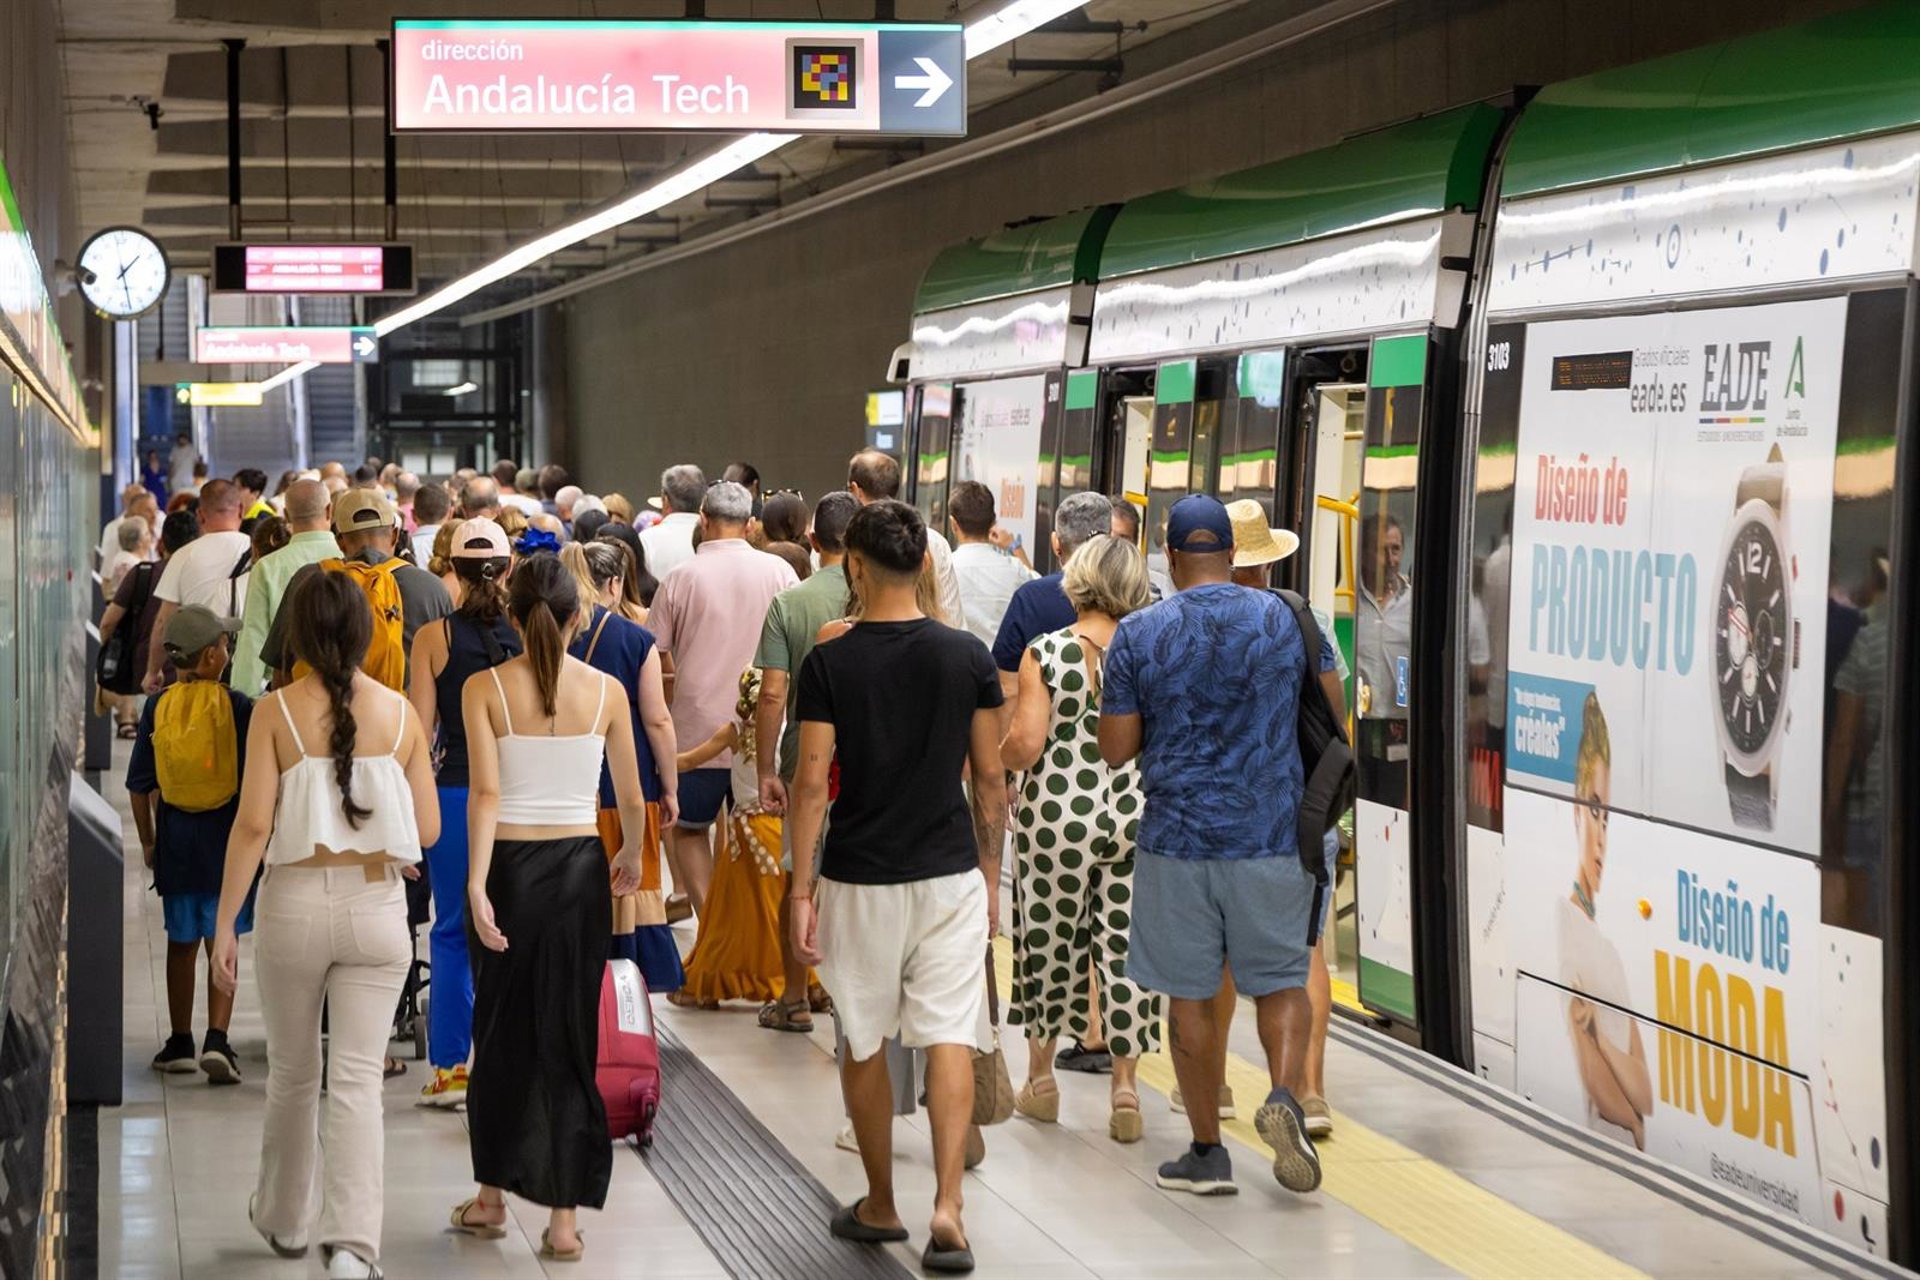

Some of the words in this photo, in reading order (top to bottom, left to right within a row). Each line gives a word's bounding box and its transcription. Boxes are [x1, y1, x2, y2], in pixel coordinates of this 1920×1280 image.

[421, 38, 524, 61] dirección
[422, 73, 636, 114] Andalucía
[652, 74, 749, 114] Tech
[1487, 342, 1510, 371] 3103
[1700, 341, 1771, 411] EADE
[1630, 373, 1687, 413] eade.es
[1534, 453, 1599, 524] Diseño
[1602, 456, 1628, 526] de
[1529, 543, 1698, 677] PRODUCTO
[1676, 868, 1754, 964] Diseño
[1760, 894, 1791, 975] de
[1654, 948, 1798, 1159] MODA
